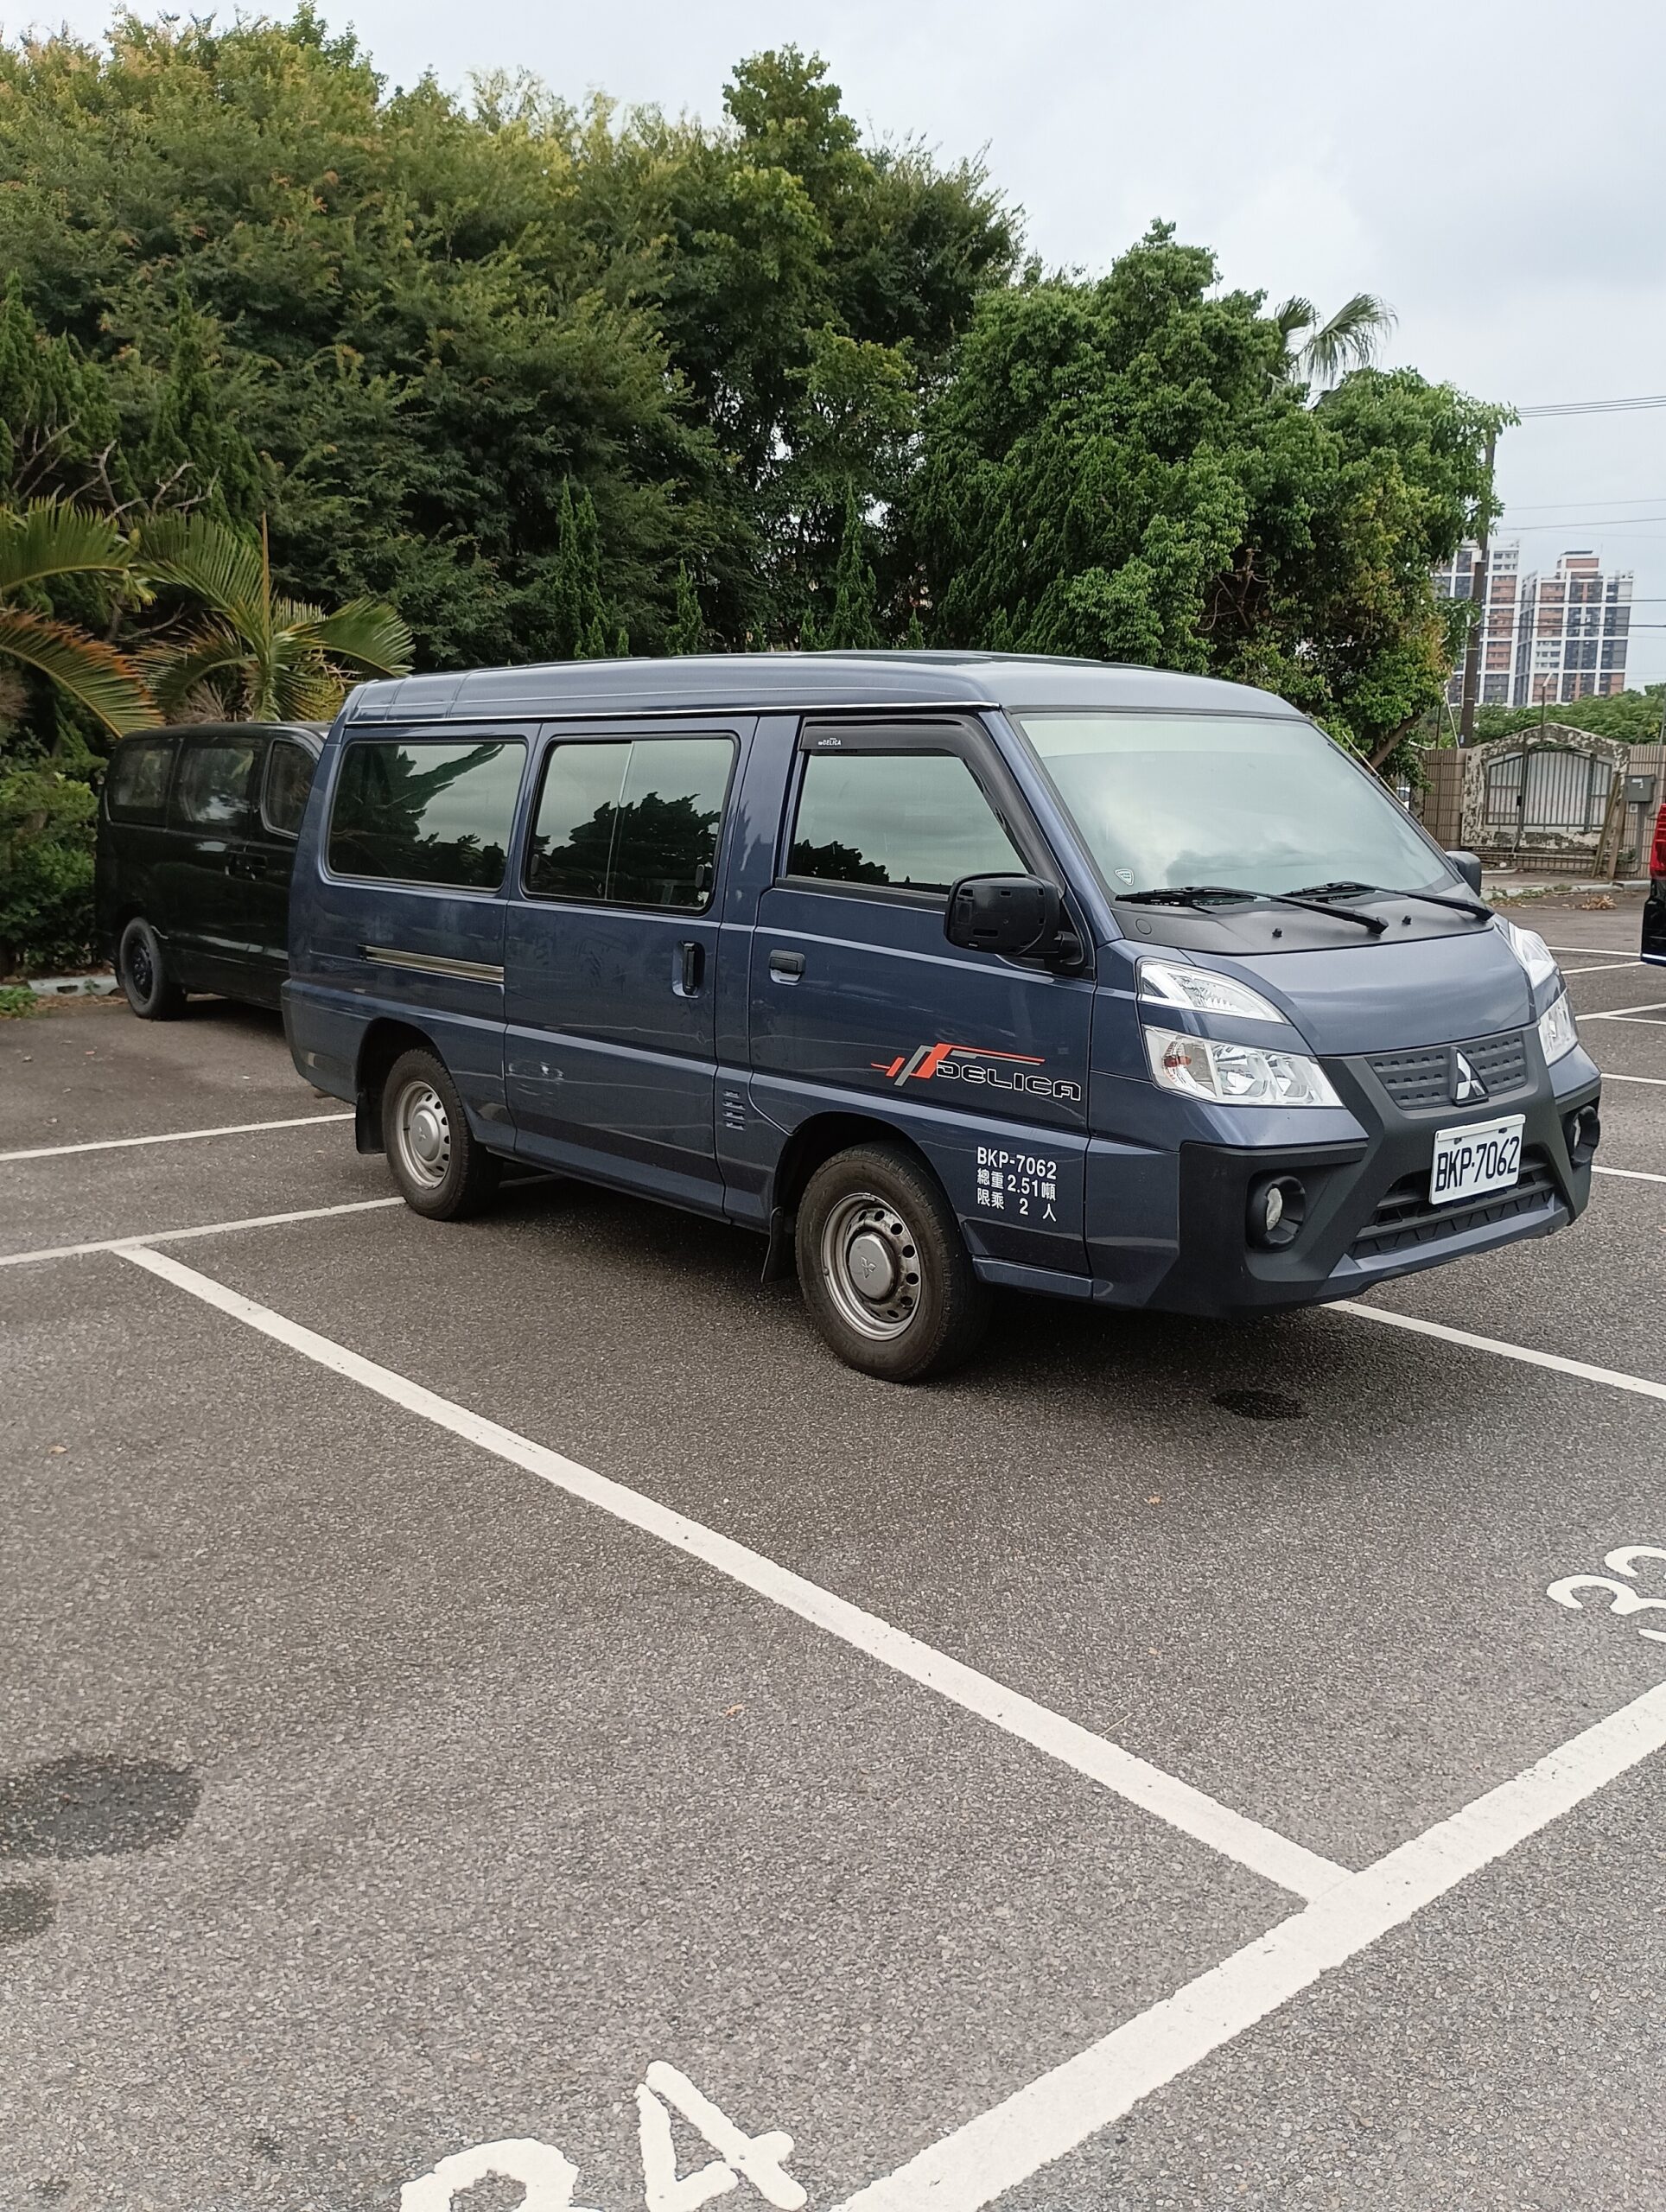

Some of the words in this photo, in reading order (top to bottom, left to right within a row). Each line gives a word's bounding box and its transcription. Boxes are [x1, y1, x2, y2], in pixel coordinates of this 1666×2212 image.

[936, 1060, 1081, 1101] DELICA
[977, 1146, 1057, 1180] BKP-7062
[1434, 1136, 1520, 1192] BKP-7062
[1019, 1198, 1028, 1215] 2
[1042, 1203, 1057, 1222] 人
